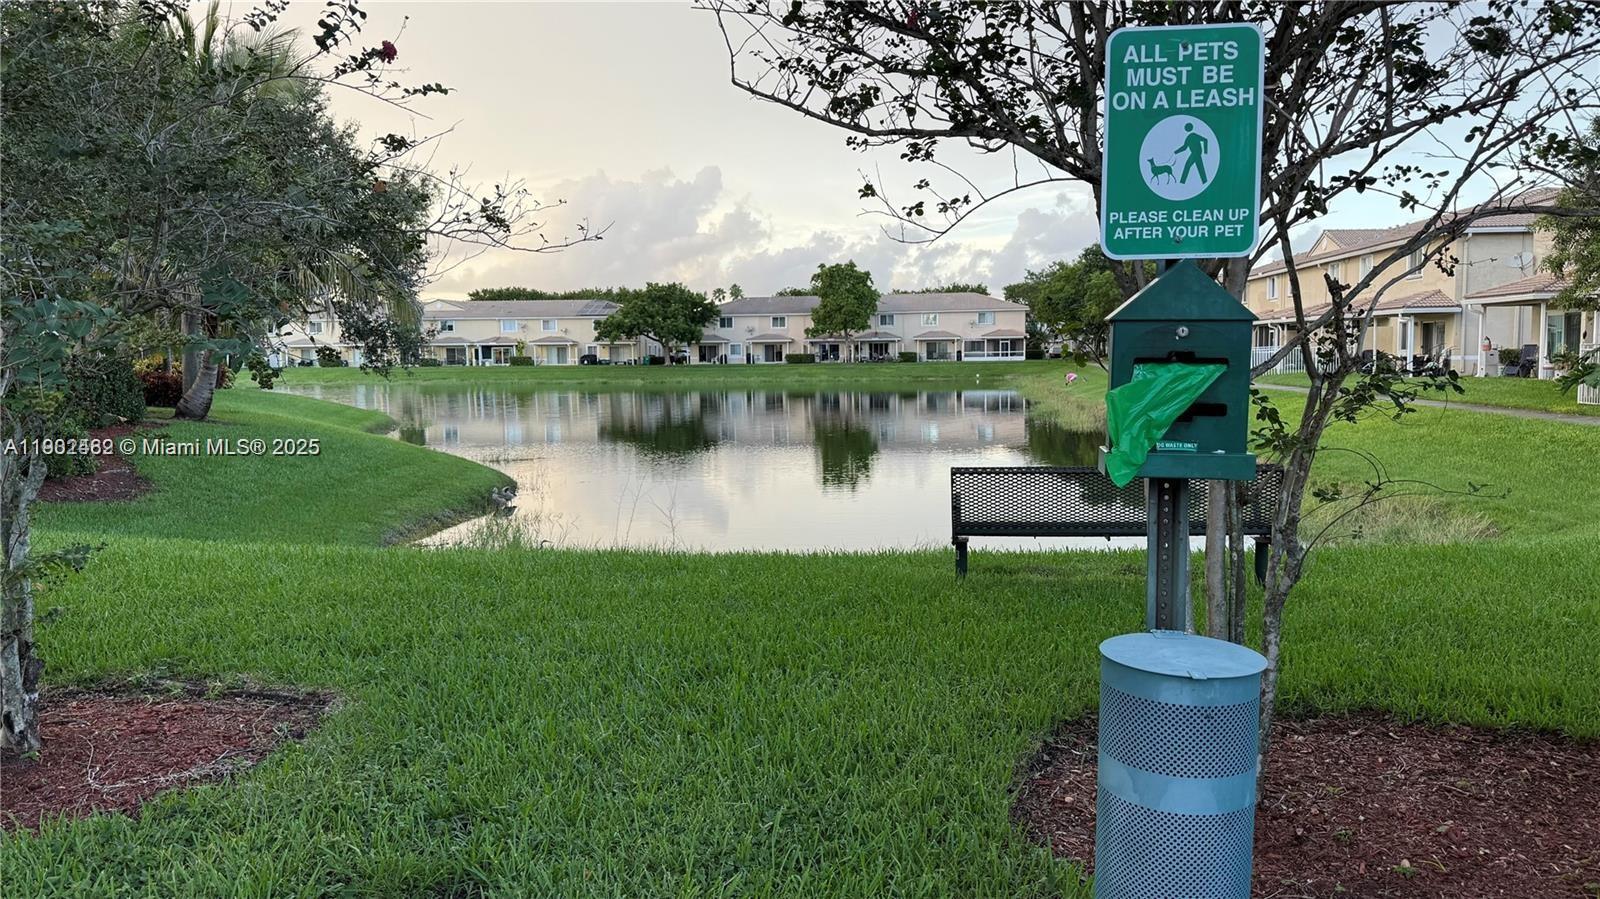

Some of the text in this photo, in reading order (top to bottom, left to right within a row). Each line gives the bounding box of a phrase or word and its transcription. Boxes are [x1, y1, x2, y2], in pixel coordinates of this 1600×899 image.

[1123, 41, 1238, 63] ALL PETS
[1127, 64, 1234, 87] MUST BE
[1112, 88, 1254, 110] ON A LEASH
[1109, 208, 1249, 224] PLEASE CLEAN UP
[1113, 224, 1244, 240] AFTER YOUR PET
